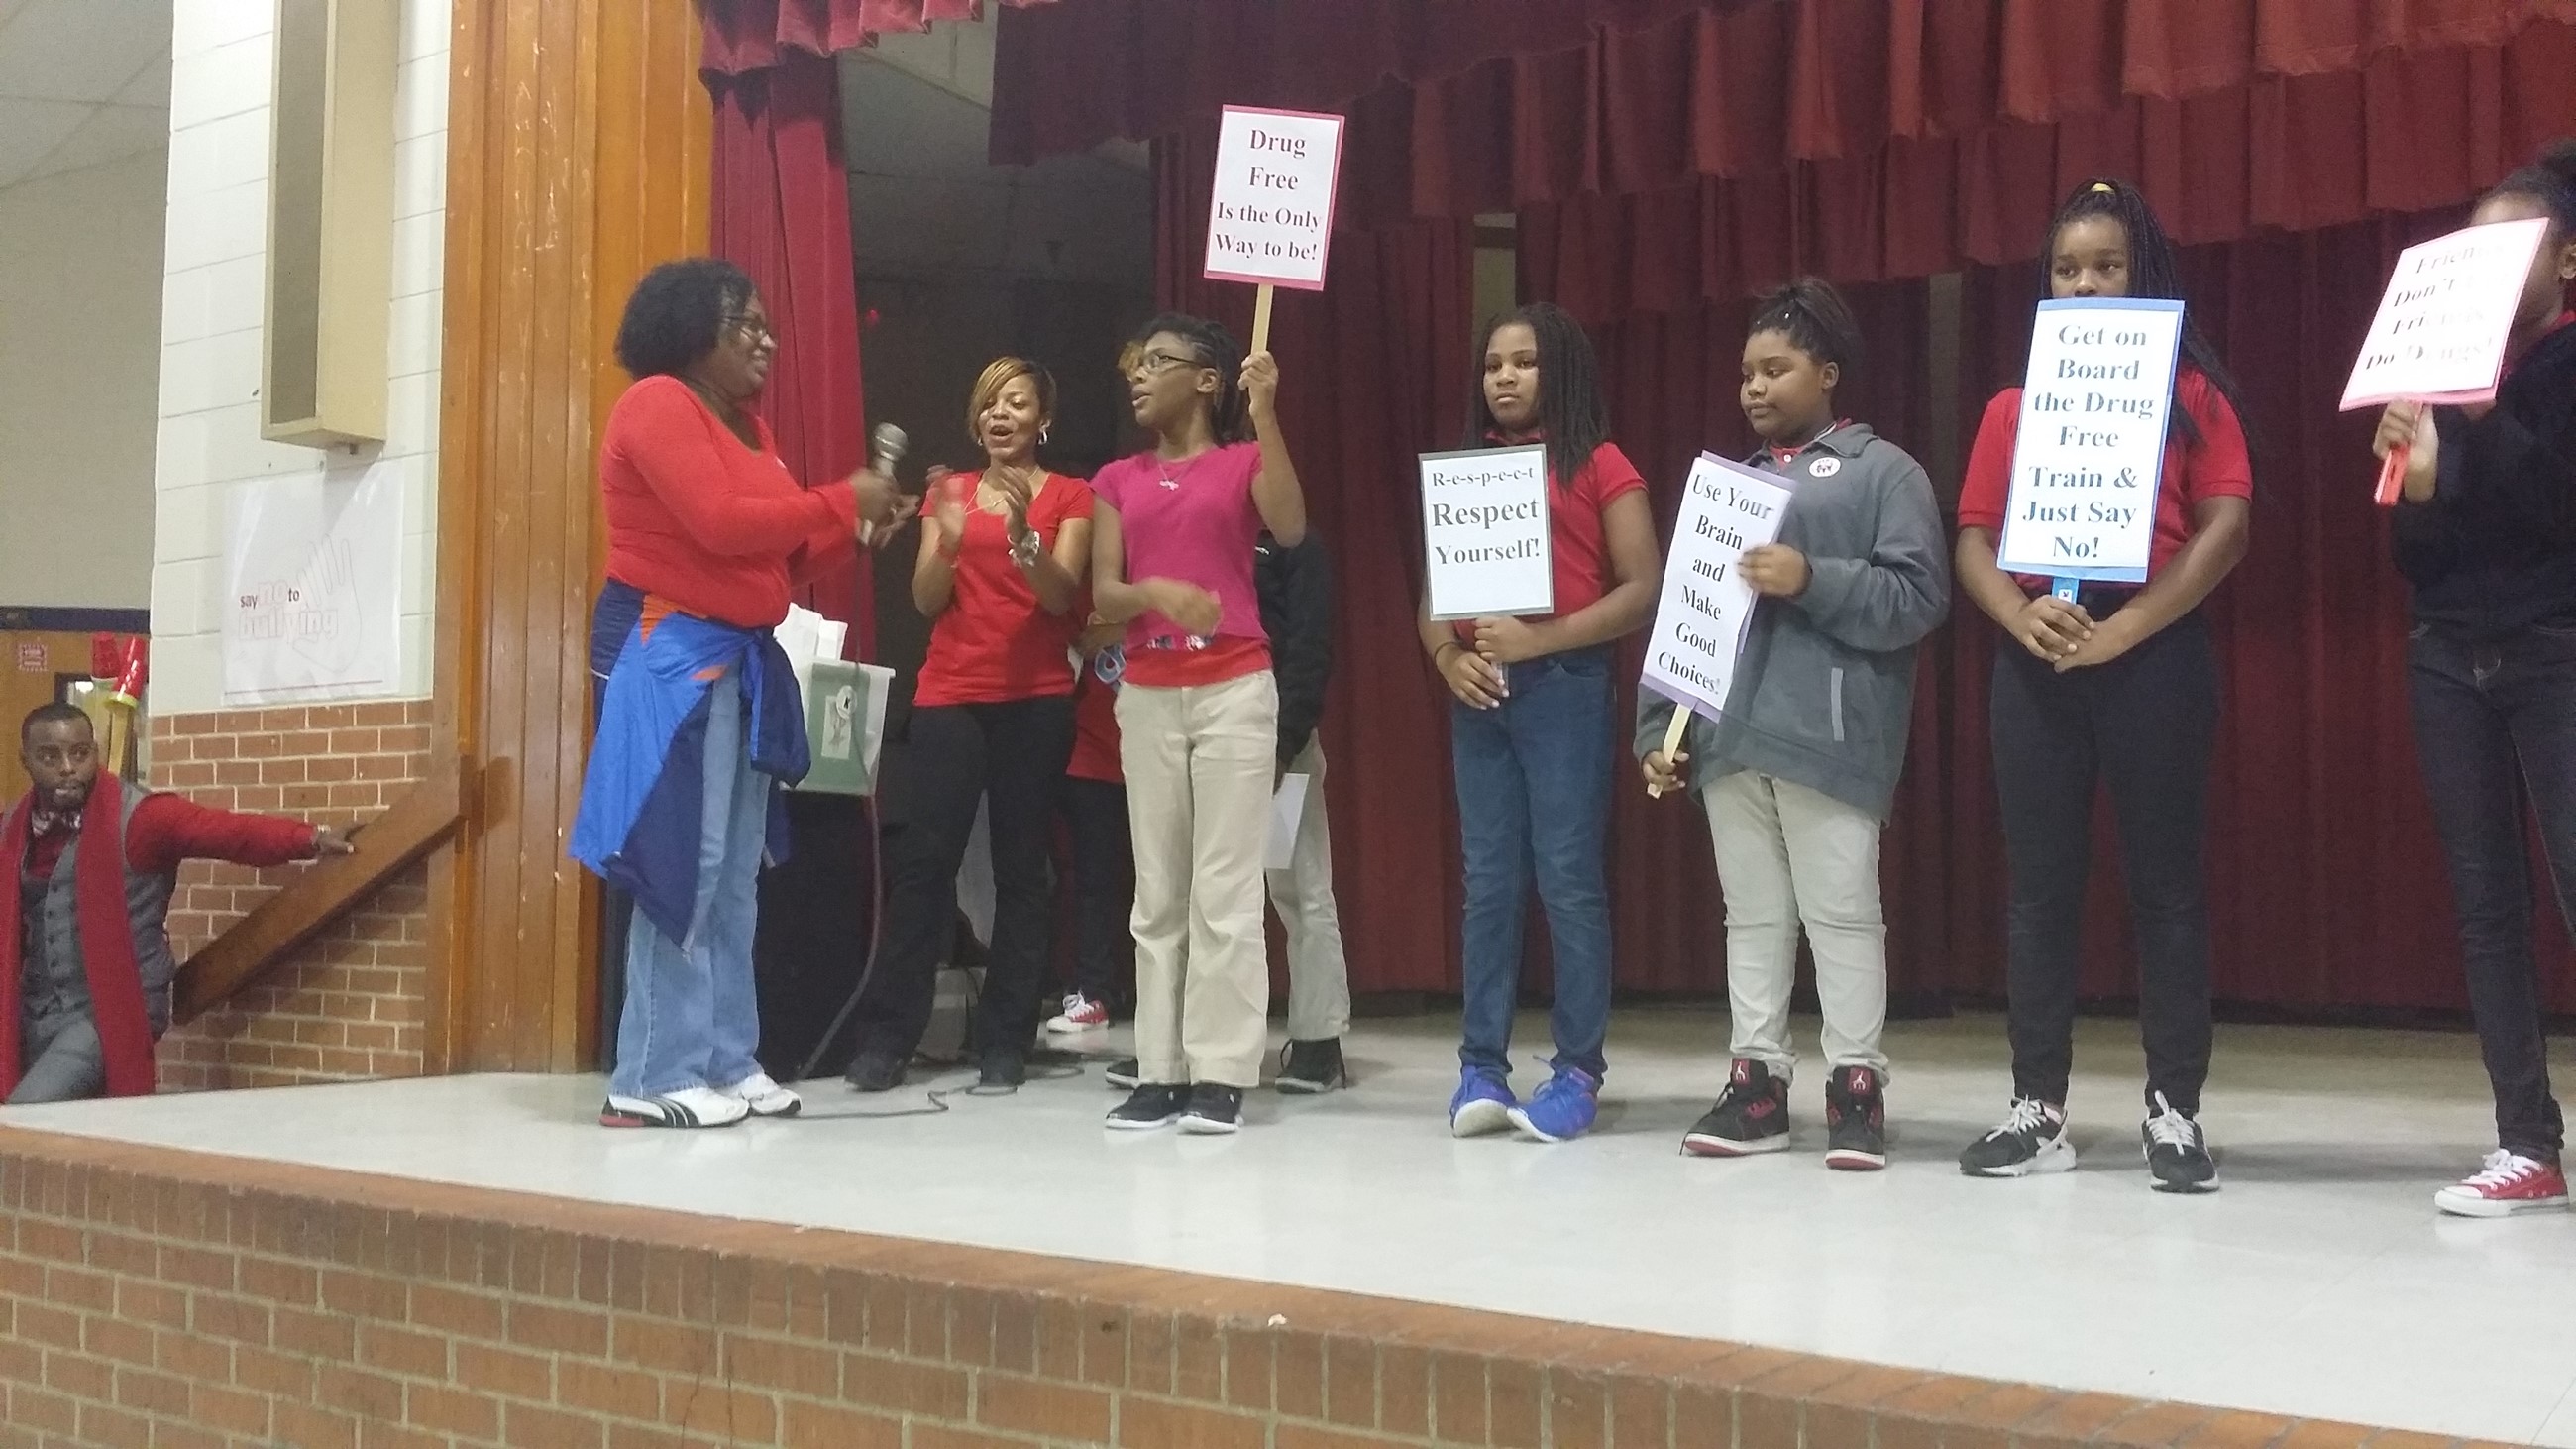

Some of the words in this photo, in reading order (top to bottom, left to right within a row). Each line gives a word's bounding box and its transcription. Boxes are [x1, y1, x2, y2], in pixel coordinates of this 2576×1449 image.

[1249, 129, 1307, 160] Drug
[1248, 167, 1299, 190] Free
[1217, 201, 1234, 220] Is
[1239, 204, 1269, 223] the
[1274, 206, 1322, 233] Only
[1216, 233, 1258, 259] Way
[1264, 240, 1282, 257] to
[1288, 241, 1318, 261] be!
[2415, 245, 2505, 274] Frien
[2394, 278, 2456, 307] Don't
[2393, 303, 2485, 335] Frins
[2058, 324, 2107, 346] Get
[2115, 329, 2147, 346] on
[2366, 353, 2396, 370] Do
[2407, 336, 2493, 364] Dugs!
[2057, 358, 2140, 380] Board
[2034, 392, 2075, 412] the
[2084, 392, 2155, 420] Drug
[2059, 425, 2119, 447] Free
[1432, 467, 1534, 487] R-e-s-p-e-c-t
[2028, 466, 2103, 488] Train
[2113, 467, 2139, 489] &
[1692, 473, 1722, 502] Use
[1727, 486, 1774, 520] Your
[1432, 497, 1539, 530] Respect
[2022, 501, 2080, 523] Just
[2088, 501, 2138, 529] Say
[1695, 513, 1744, 551] Brain
[1435, 537, 1540, 565] Yourself!
[2053, 536, 2099, 558] No!
[1692, 557, 1726, 583] and
[240, 595, 258, 610] say
[258, 579, 289, 606] no
[288, 587, 300, 602] to
[1680, 585, 1721, 621] Make
[239, 604, 339, 646] bullying
[1675, 621, 1716, 658] Good
